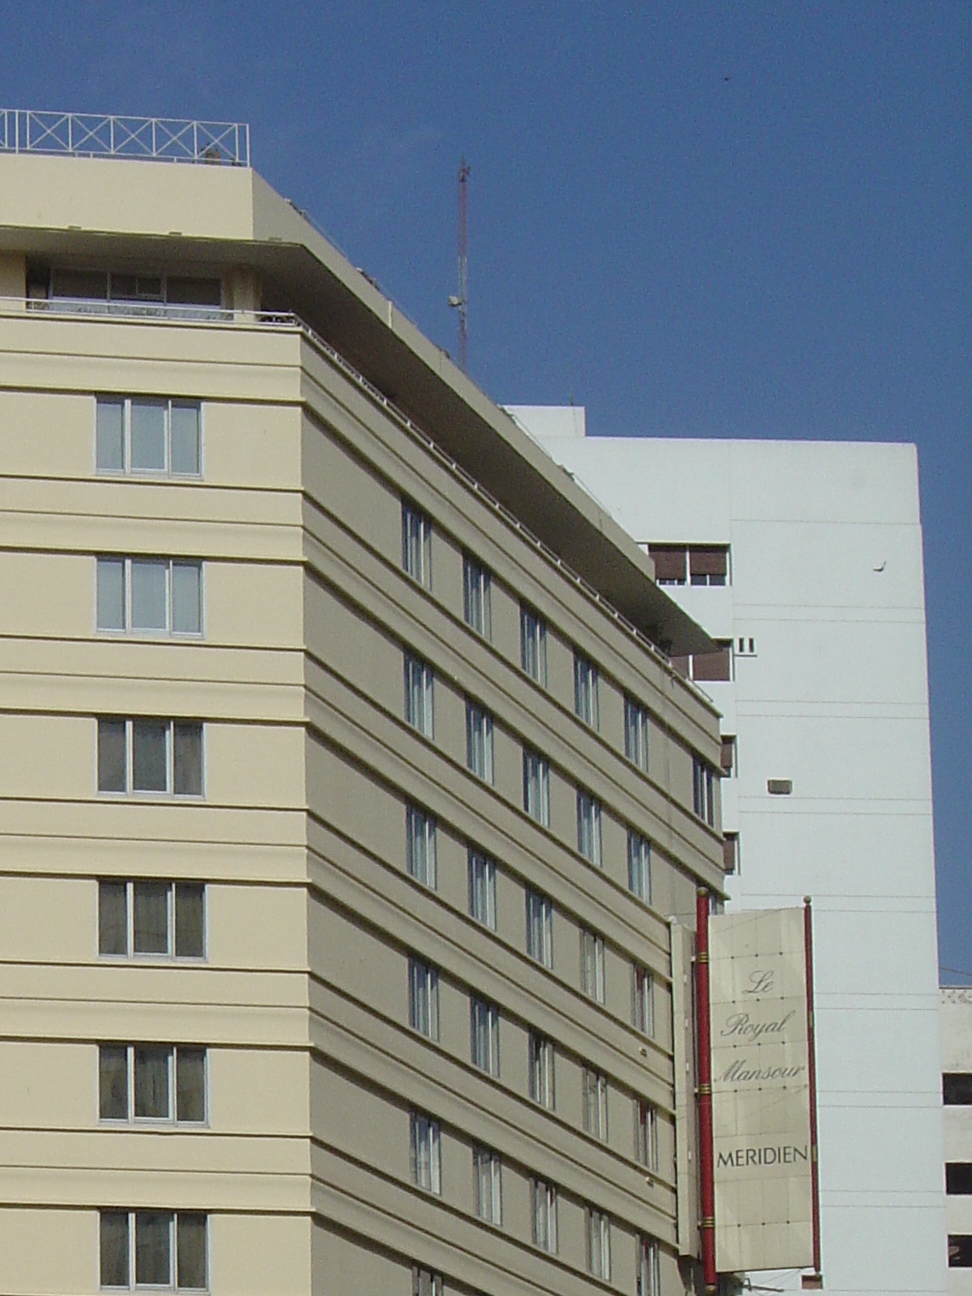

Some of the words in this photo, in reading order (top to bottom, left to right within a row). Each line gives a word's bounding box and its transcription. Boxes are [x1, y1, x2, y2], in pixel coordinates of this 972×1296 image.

[741, 970, 774, 994] Le
[720, 1010, 796, 1042] Royal
[713, 1060, 806, 1083] Mansour
[716, 1145, 808, 1168] MERIDIEN
